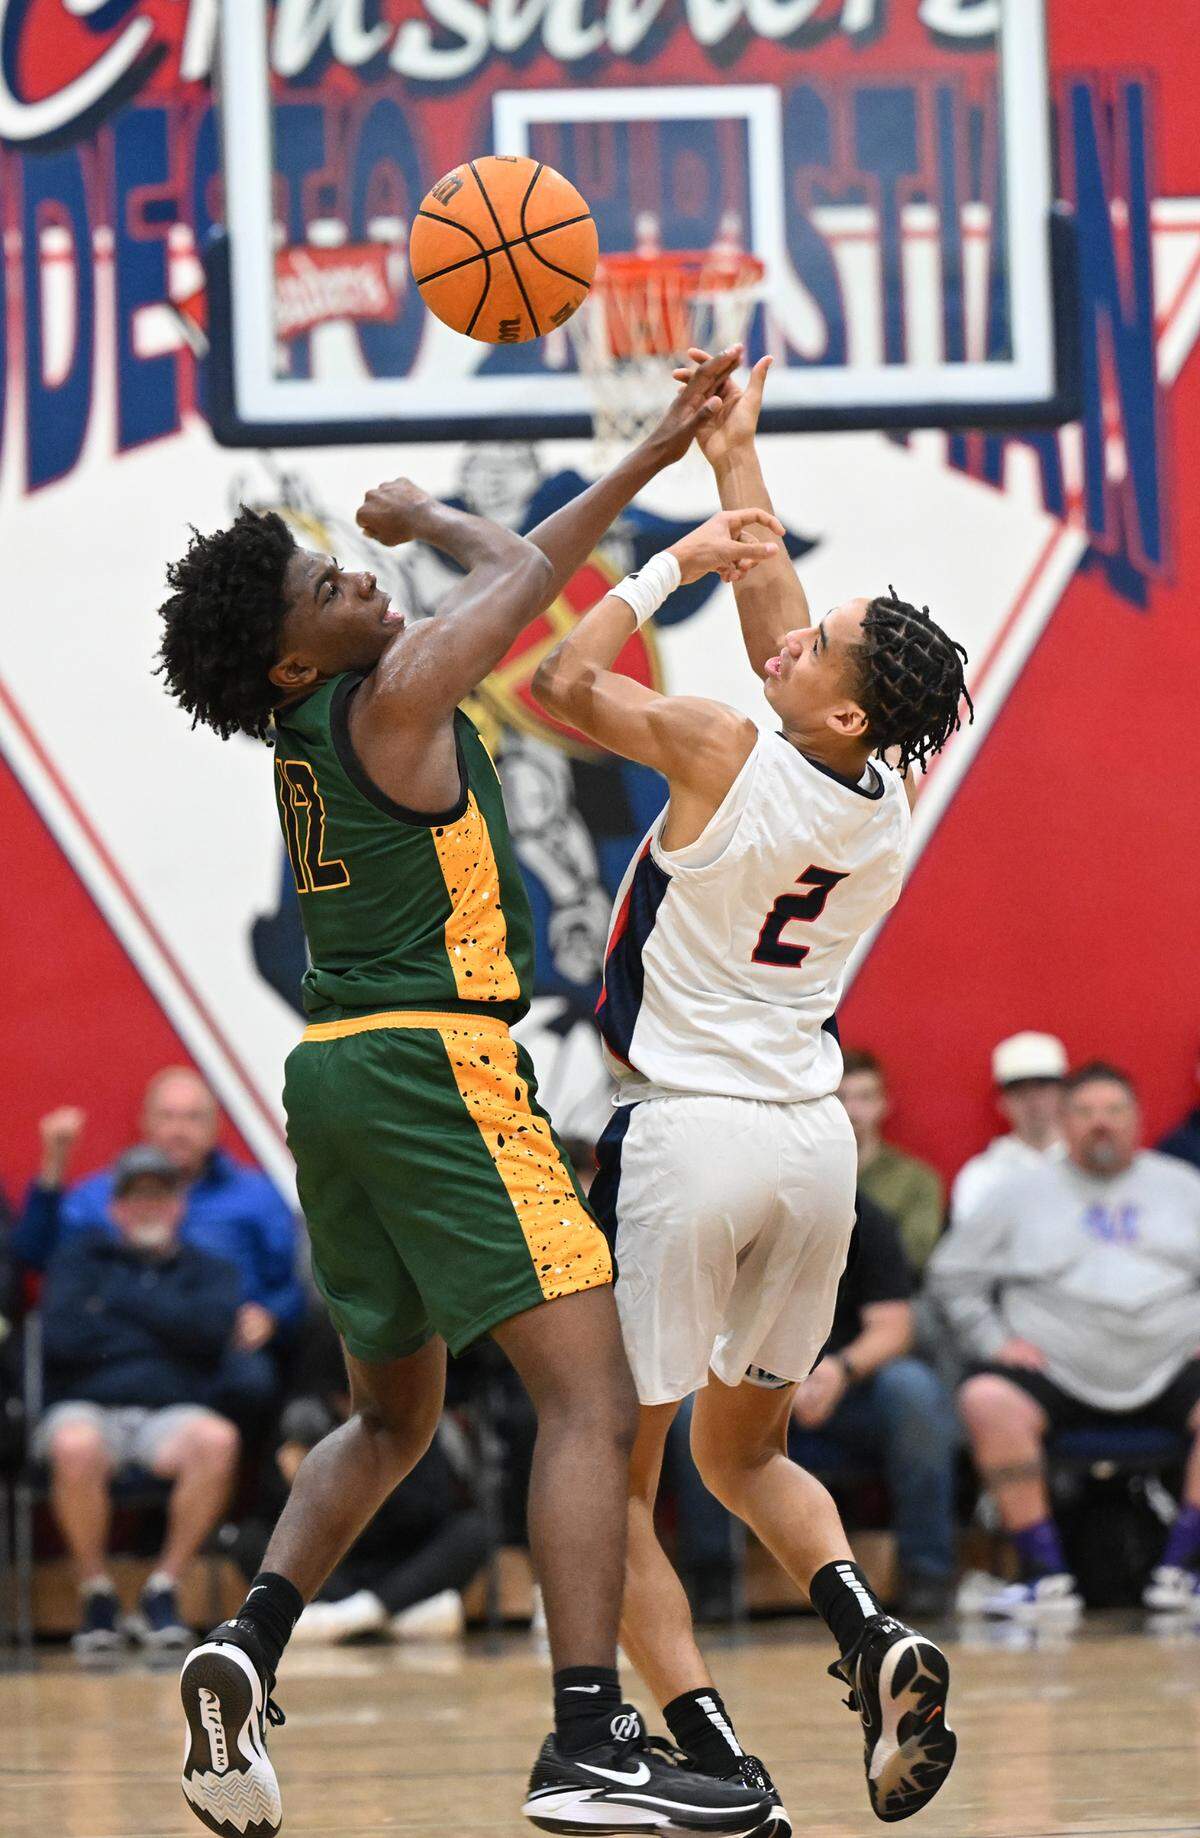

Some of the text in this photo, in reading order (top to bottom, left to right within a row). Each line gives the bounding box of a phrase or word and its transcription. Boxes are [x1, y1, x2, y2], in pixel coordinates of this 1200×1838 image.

[274, 757, 350, 894] 12
[751, 864, 851, 968] 2
[215, 1729, 224, 1766] ZOOM
